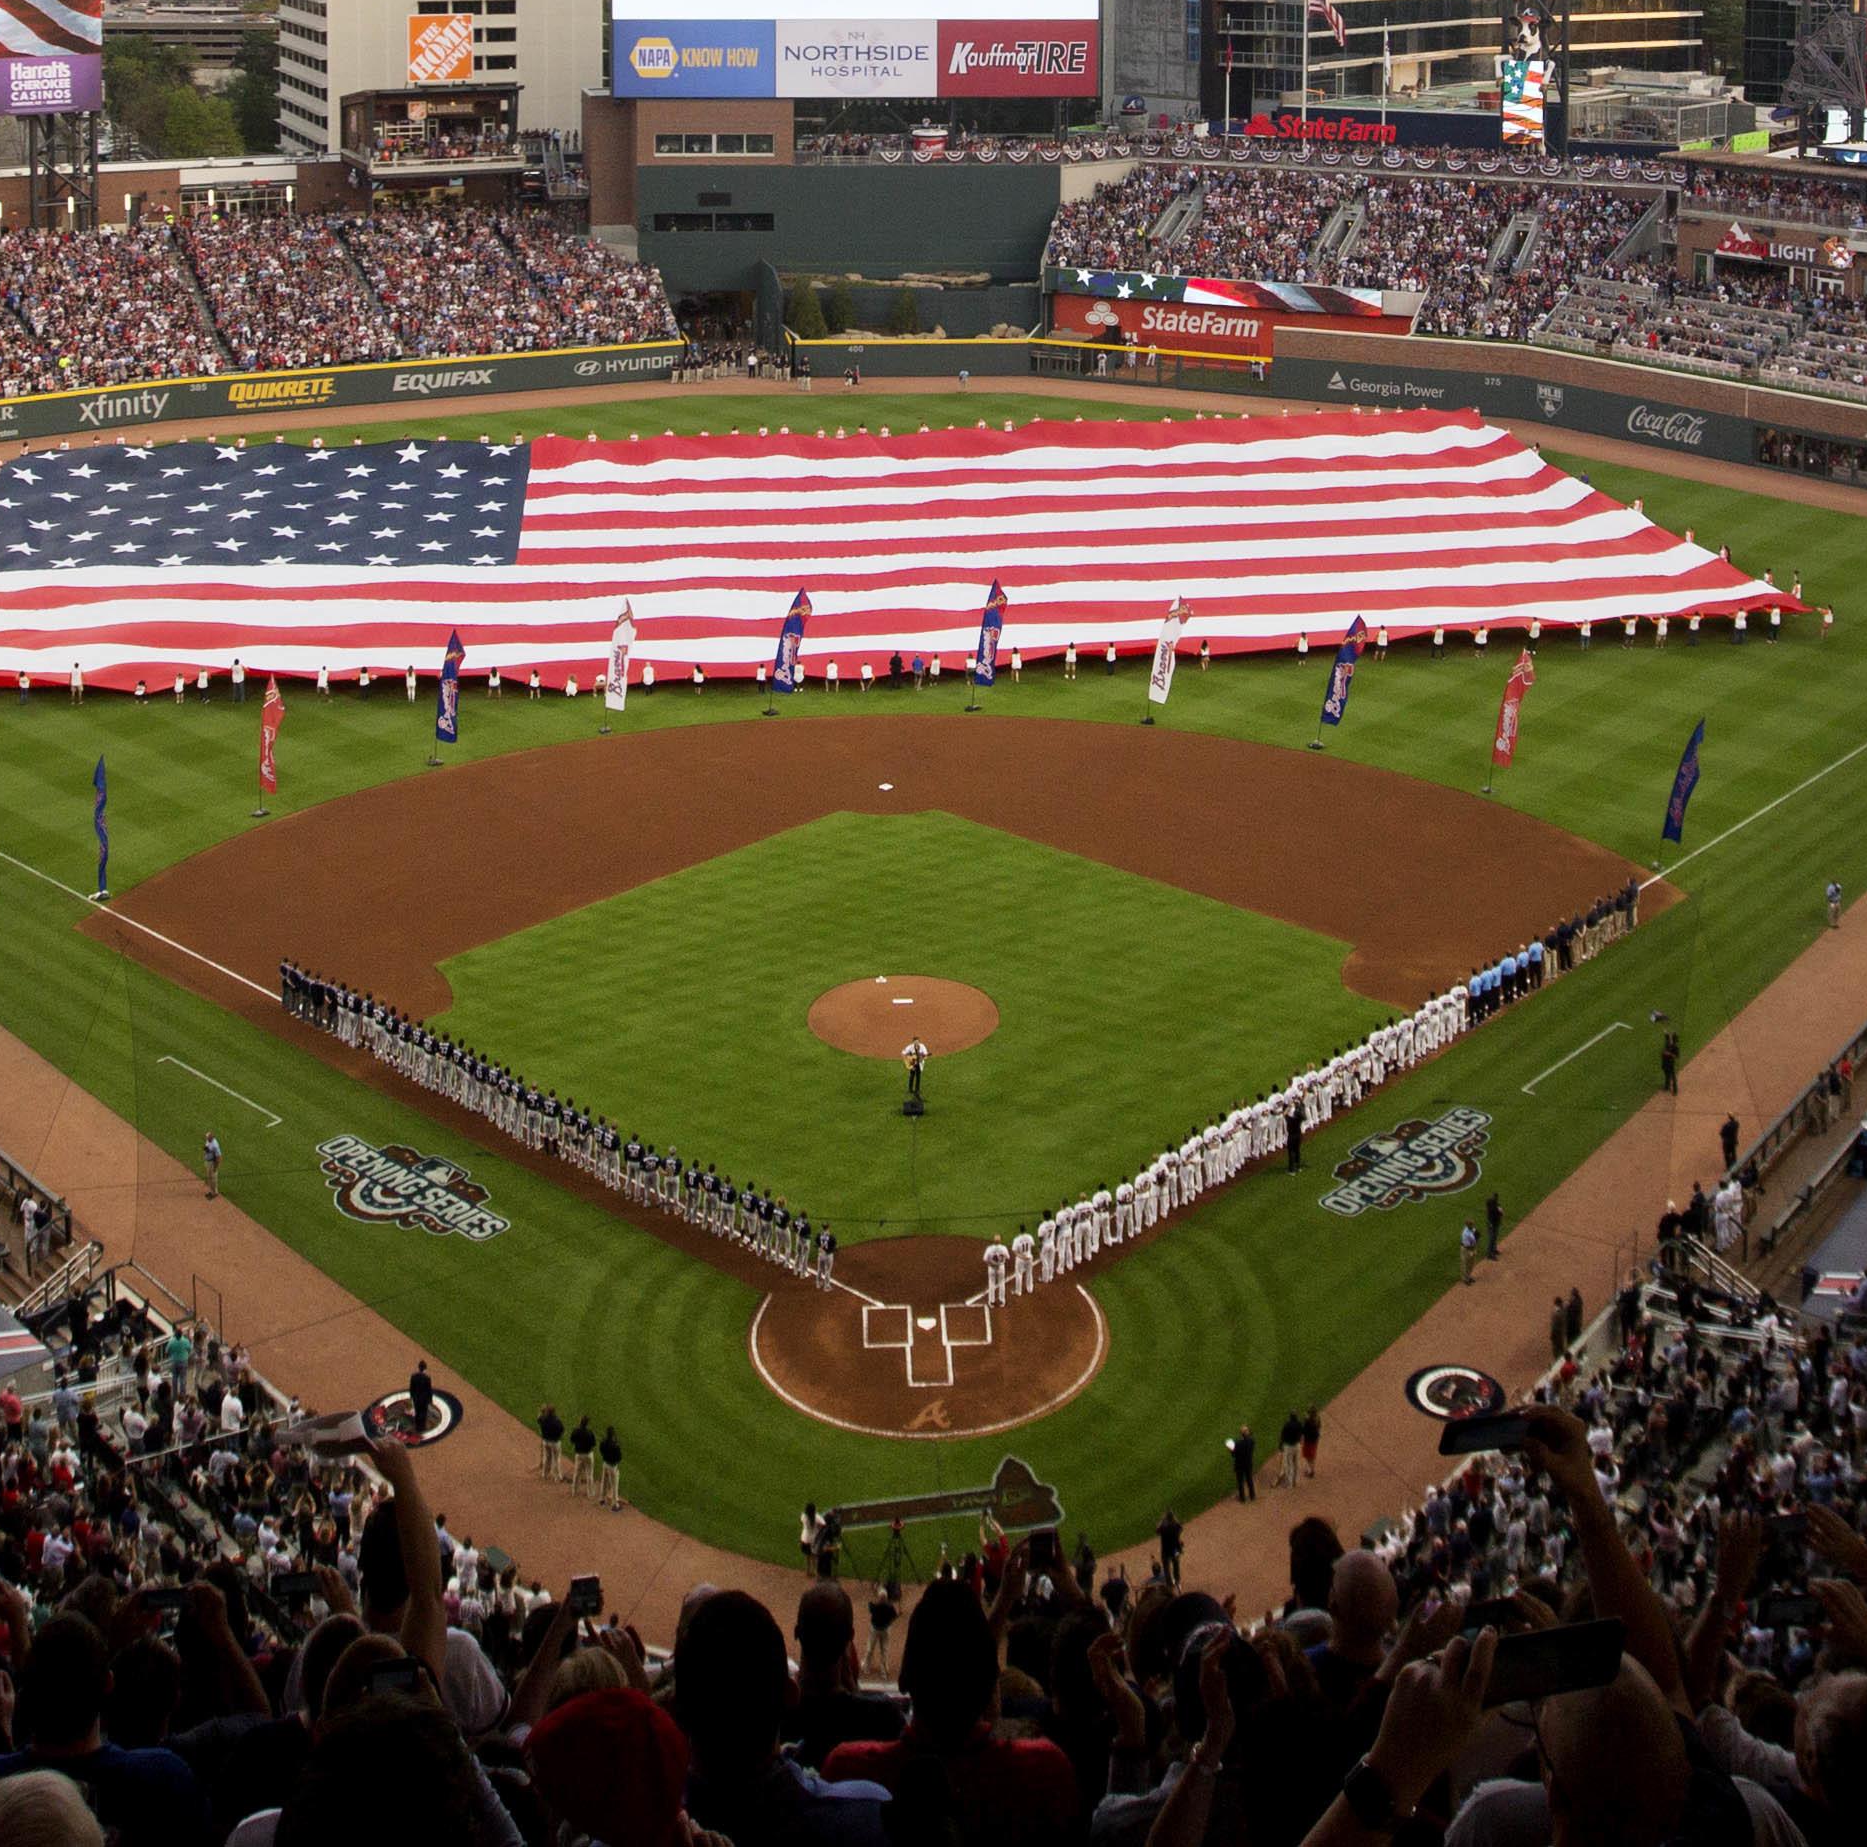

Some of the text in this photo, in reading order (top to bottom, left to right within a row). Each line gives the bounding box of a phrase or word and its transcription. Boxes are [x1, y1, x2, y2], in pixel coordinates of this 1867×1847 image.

[409, 13, 473, 81] HOME
[638, 48, 759, 67] NAPA KNOW HOW
[784, 45, 930, 62] NORTHSIDE
[948, 41, 1088, 75] Kauffman TIRE
[811, 66, 903, 78] HOSPITAL
[11, 79, 71, 91] CHEROKEE
[11, 89, 72, 101] CASINOS
[1770, 244, 1817, 263] LIGHT
[606, 355, 678, 373] HYUNDA
[228, 377, 336, 402] QUIKRETE
[393, 368, 496, 394] EQUIFAX
[1350, 377, 1445, 400] Georgia Power
[1484, 378, 1502, 387] 375
[1538, 385, 1564, 400] MLB
[79, 390, 170, 427] xfinity
[1628, 405, 1708, 446] Coca-Cola
[1324, 1107, 1489, 1216] OPENING SERIES
[322, 1135, 506, 1240] OPENING SERIES
